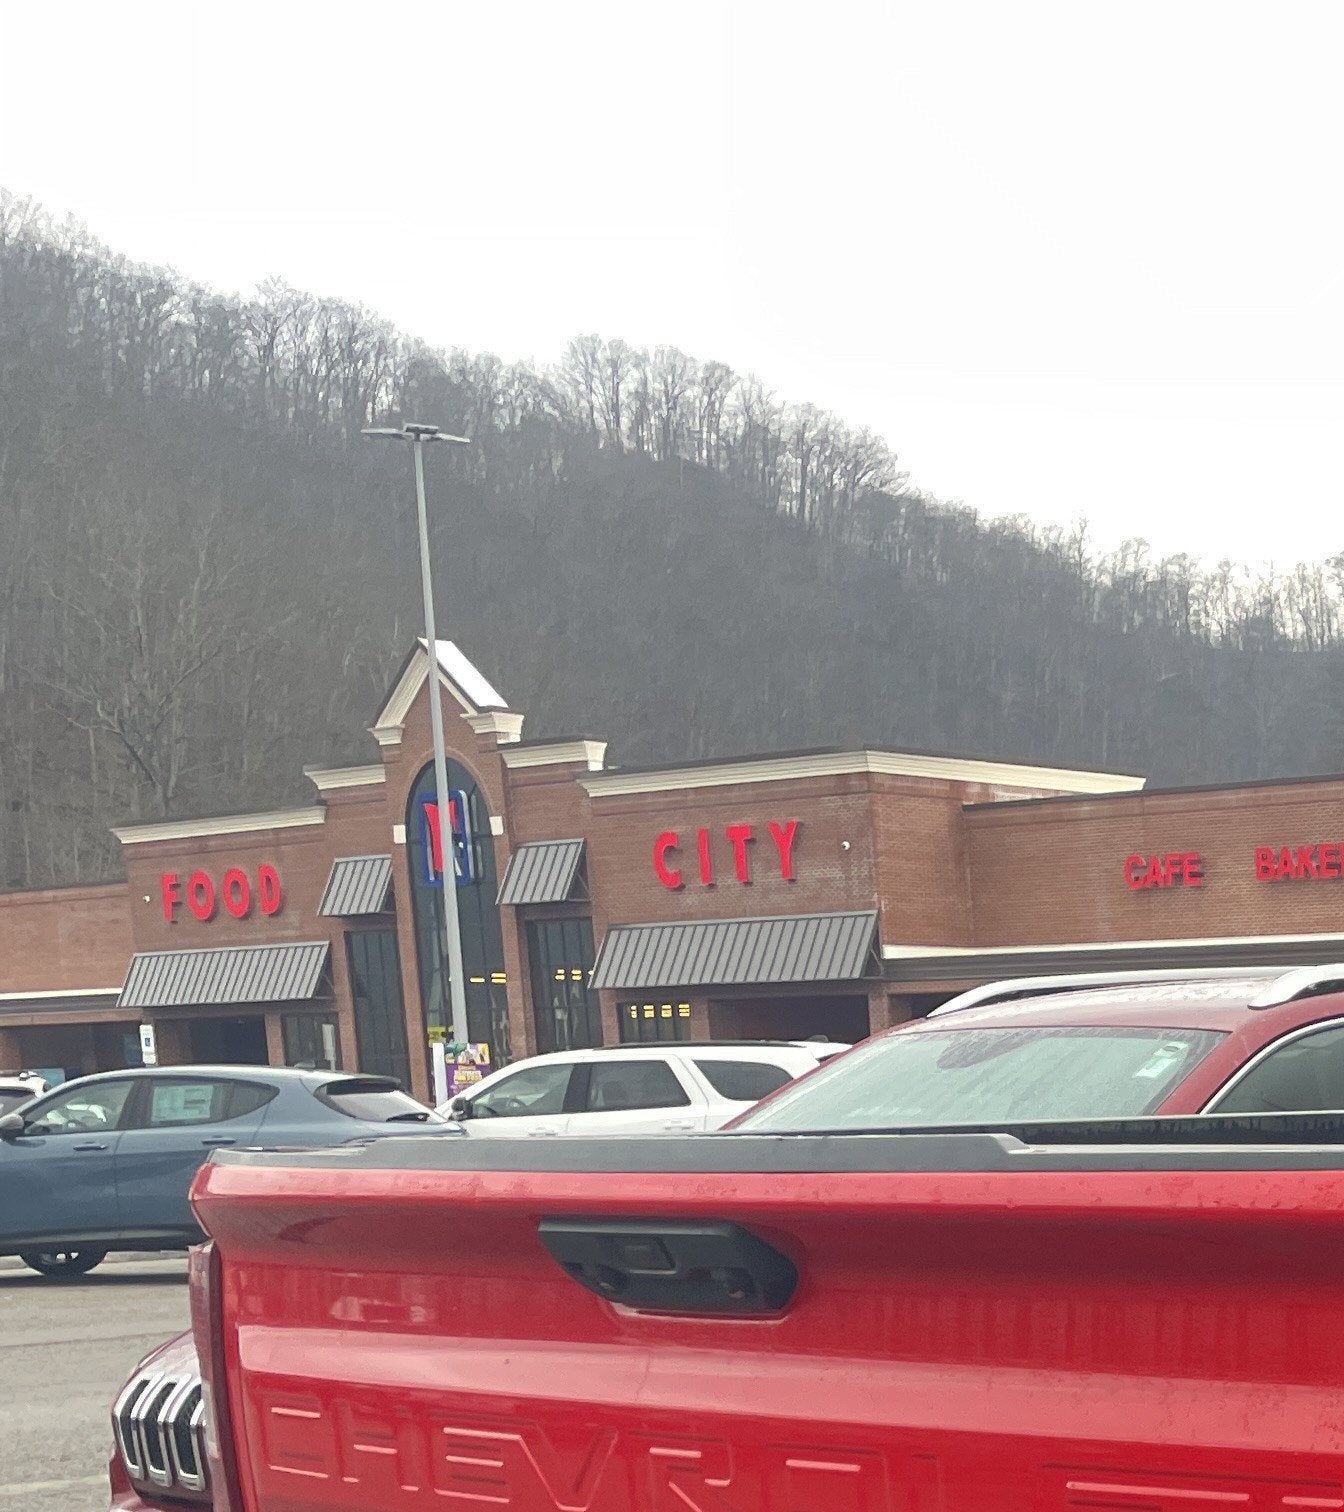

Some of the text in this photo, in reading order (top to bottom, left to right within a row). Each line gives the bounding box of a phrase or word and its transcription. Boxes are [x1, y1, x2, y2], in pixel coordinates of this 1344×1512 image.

[161, 818, 799, 923] FOOD CITY
[1124, 852, 1202, 889] CAFE
